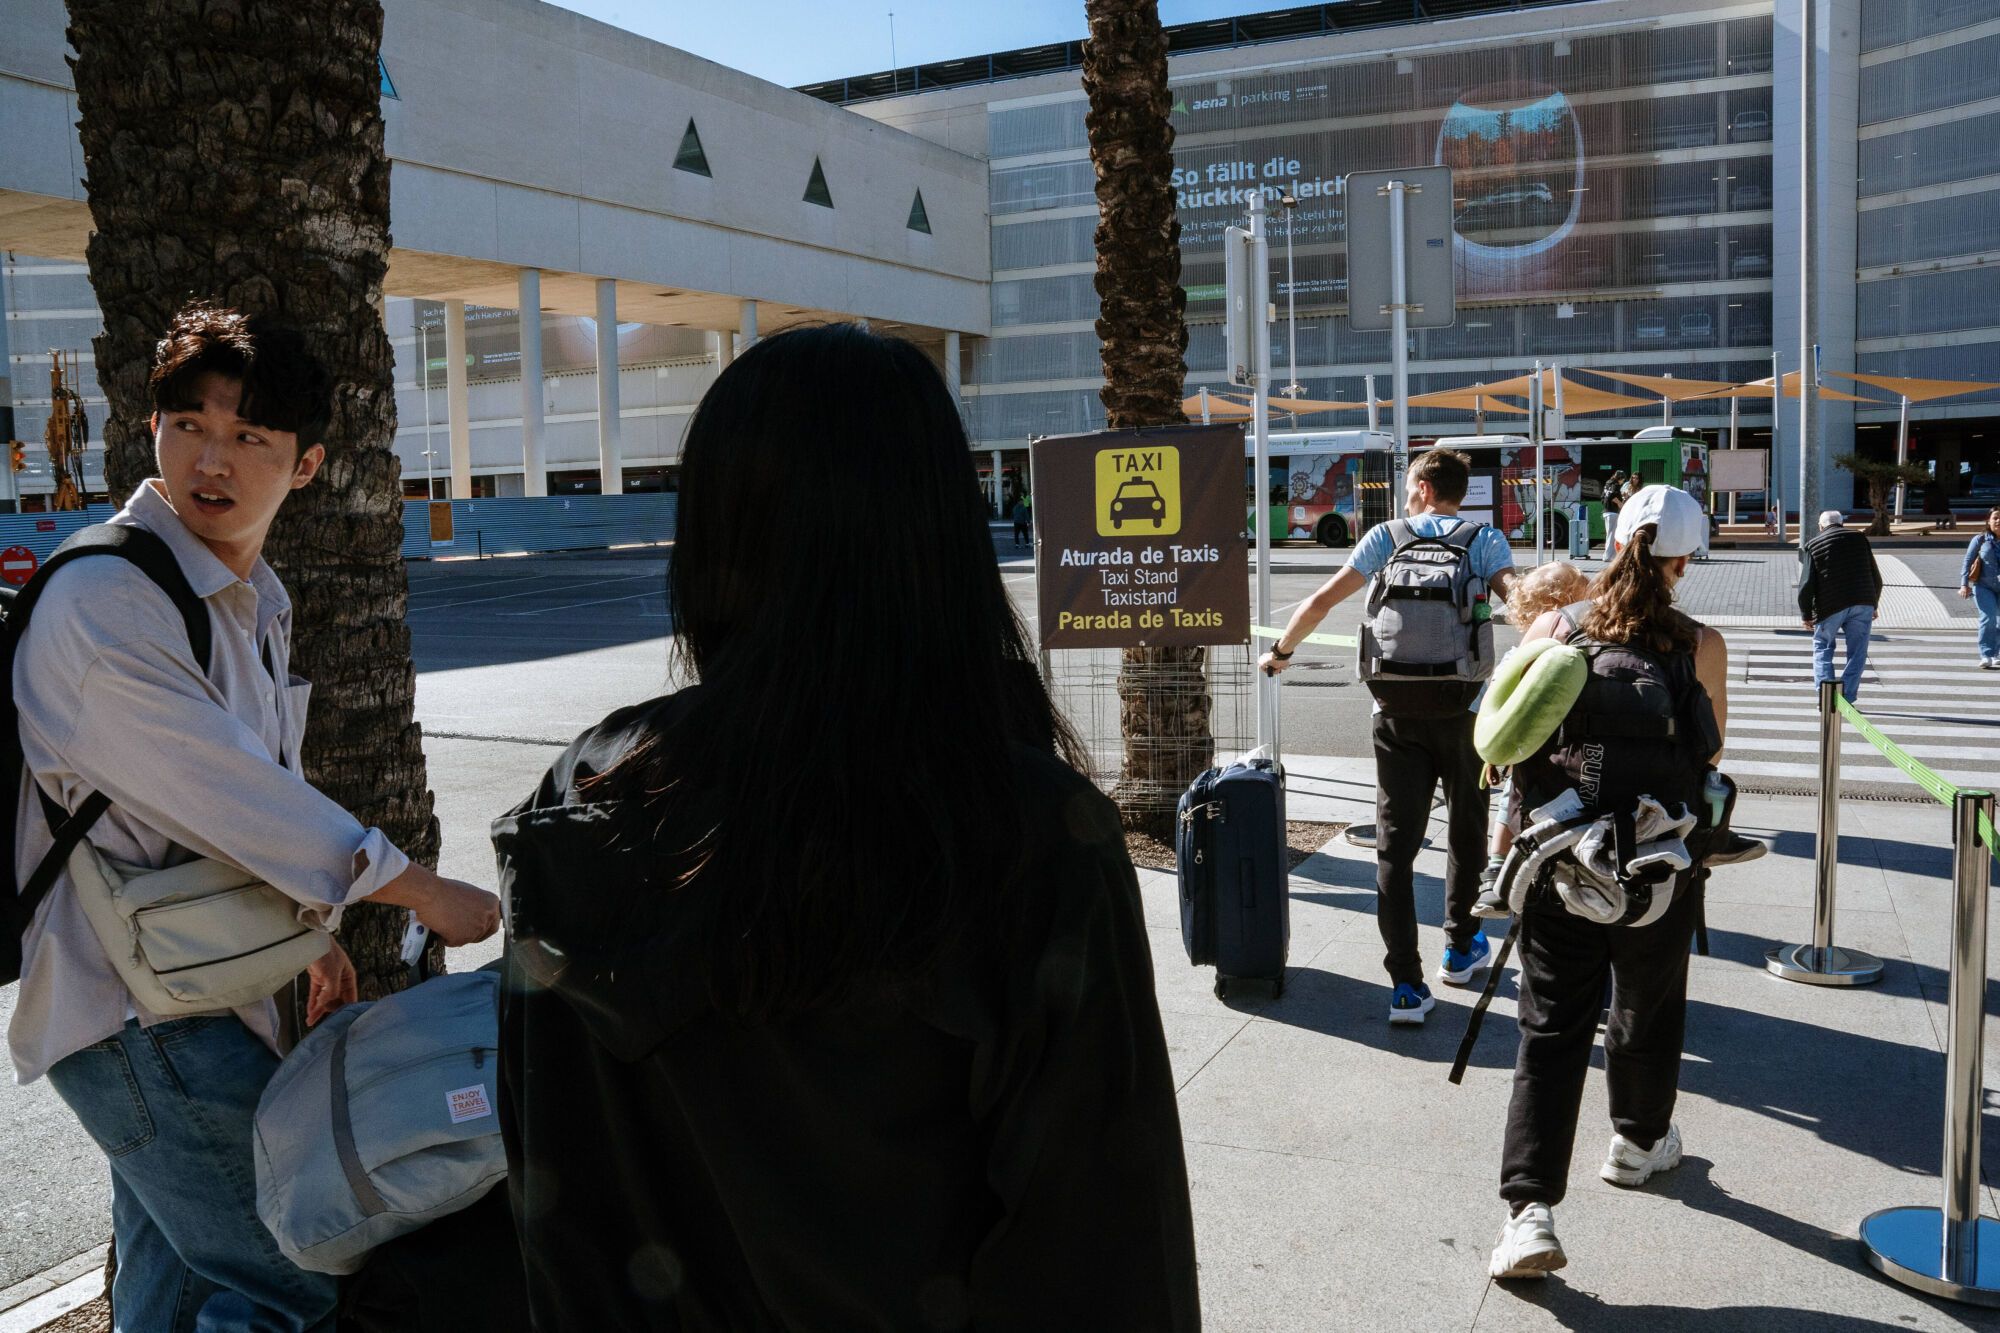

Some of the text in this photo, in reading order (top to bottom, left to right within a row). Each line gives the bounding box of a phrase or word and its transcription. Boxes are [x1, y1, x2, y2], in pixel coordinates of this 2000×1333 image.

[1192, 95, 1228, 110] aena
[1241, 88, 1291, 107] parking
[1171, 157, 1301, 188] So fällt die
[1293, 175, 1346, 198] leich
[1180, 220, 1198, 232] ach
[1112, 452, 1163, 473] TAXI
[1060, 544, 1220, 567] Aturada de Taxis
[1099, 568, 1179, 585] Taxi Stand
[1101, 588, 1178, 606] Taxistand
[1058, 608, 1223, 631] Parada de Taxis
[1579, 743, 1604, 808] BURT
[452, 1089, 480, 1102] ENJOY
[453, 1098, 487, 1111] TRAVEL
